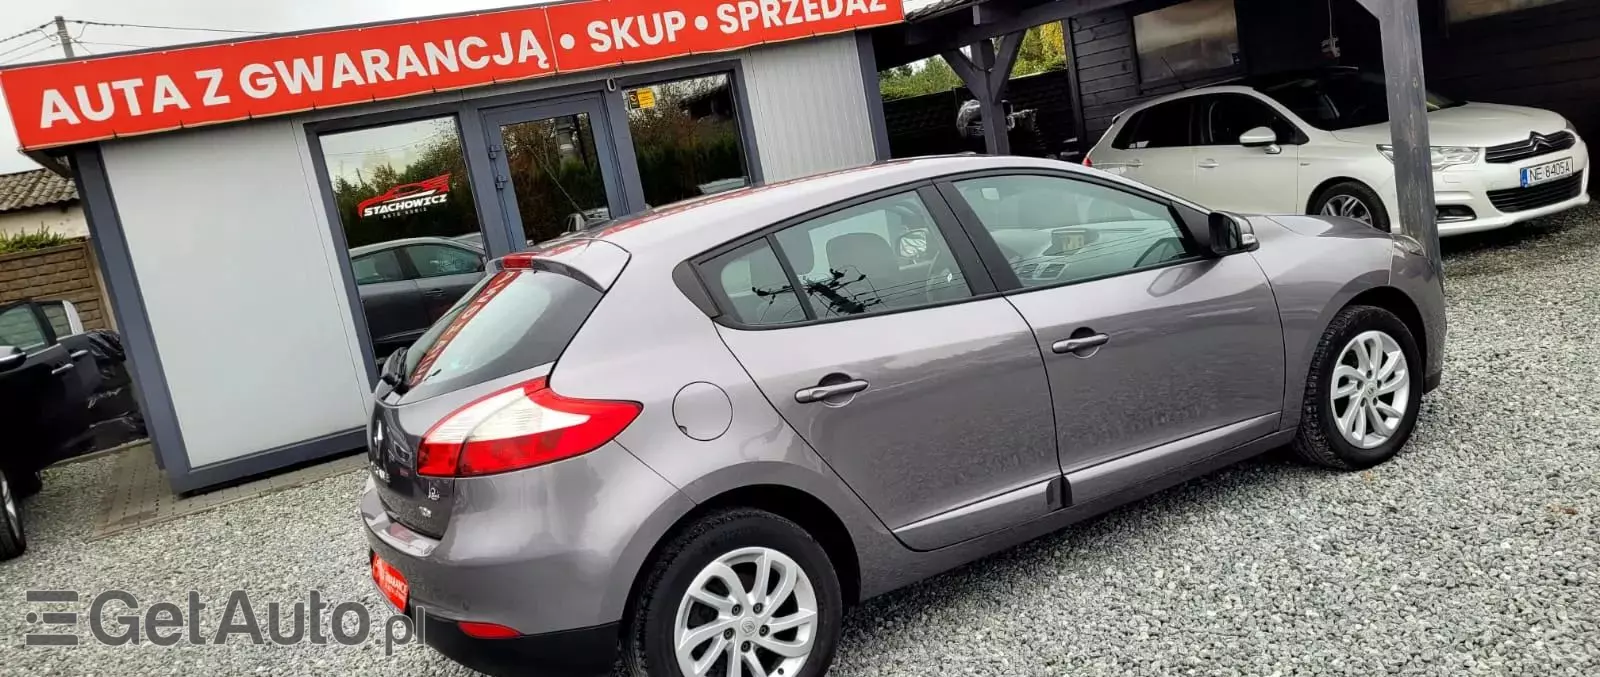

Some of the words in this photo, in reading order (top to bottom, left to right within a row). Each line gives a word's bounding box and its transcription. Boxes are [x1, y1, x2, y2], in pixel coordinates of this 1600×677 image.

[40, 75, 191, 129] AUTA
[195, 69, 230, 106] Z
[240, 29, 550, 99] GWARANCJĄ
[587, 11, 686, 53] SKUP
[1529, 167, 1542, 181] NE
[364, 194, 447, 216] STACHOWICZ
